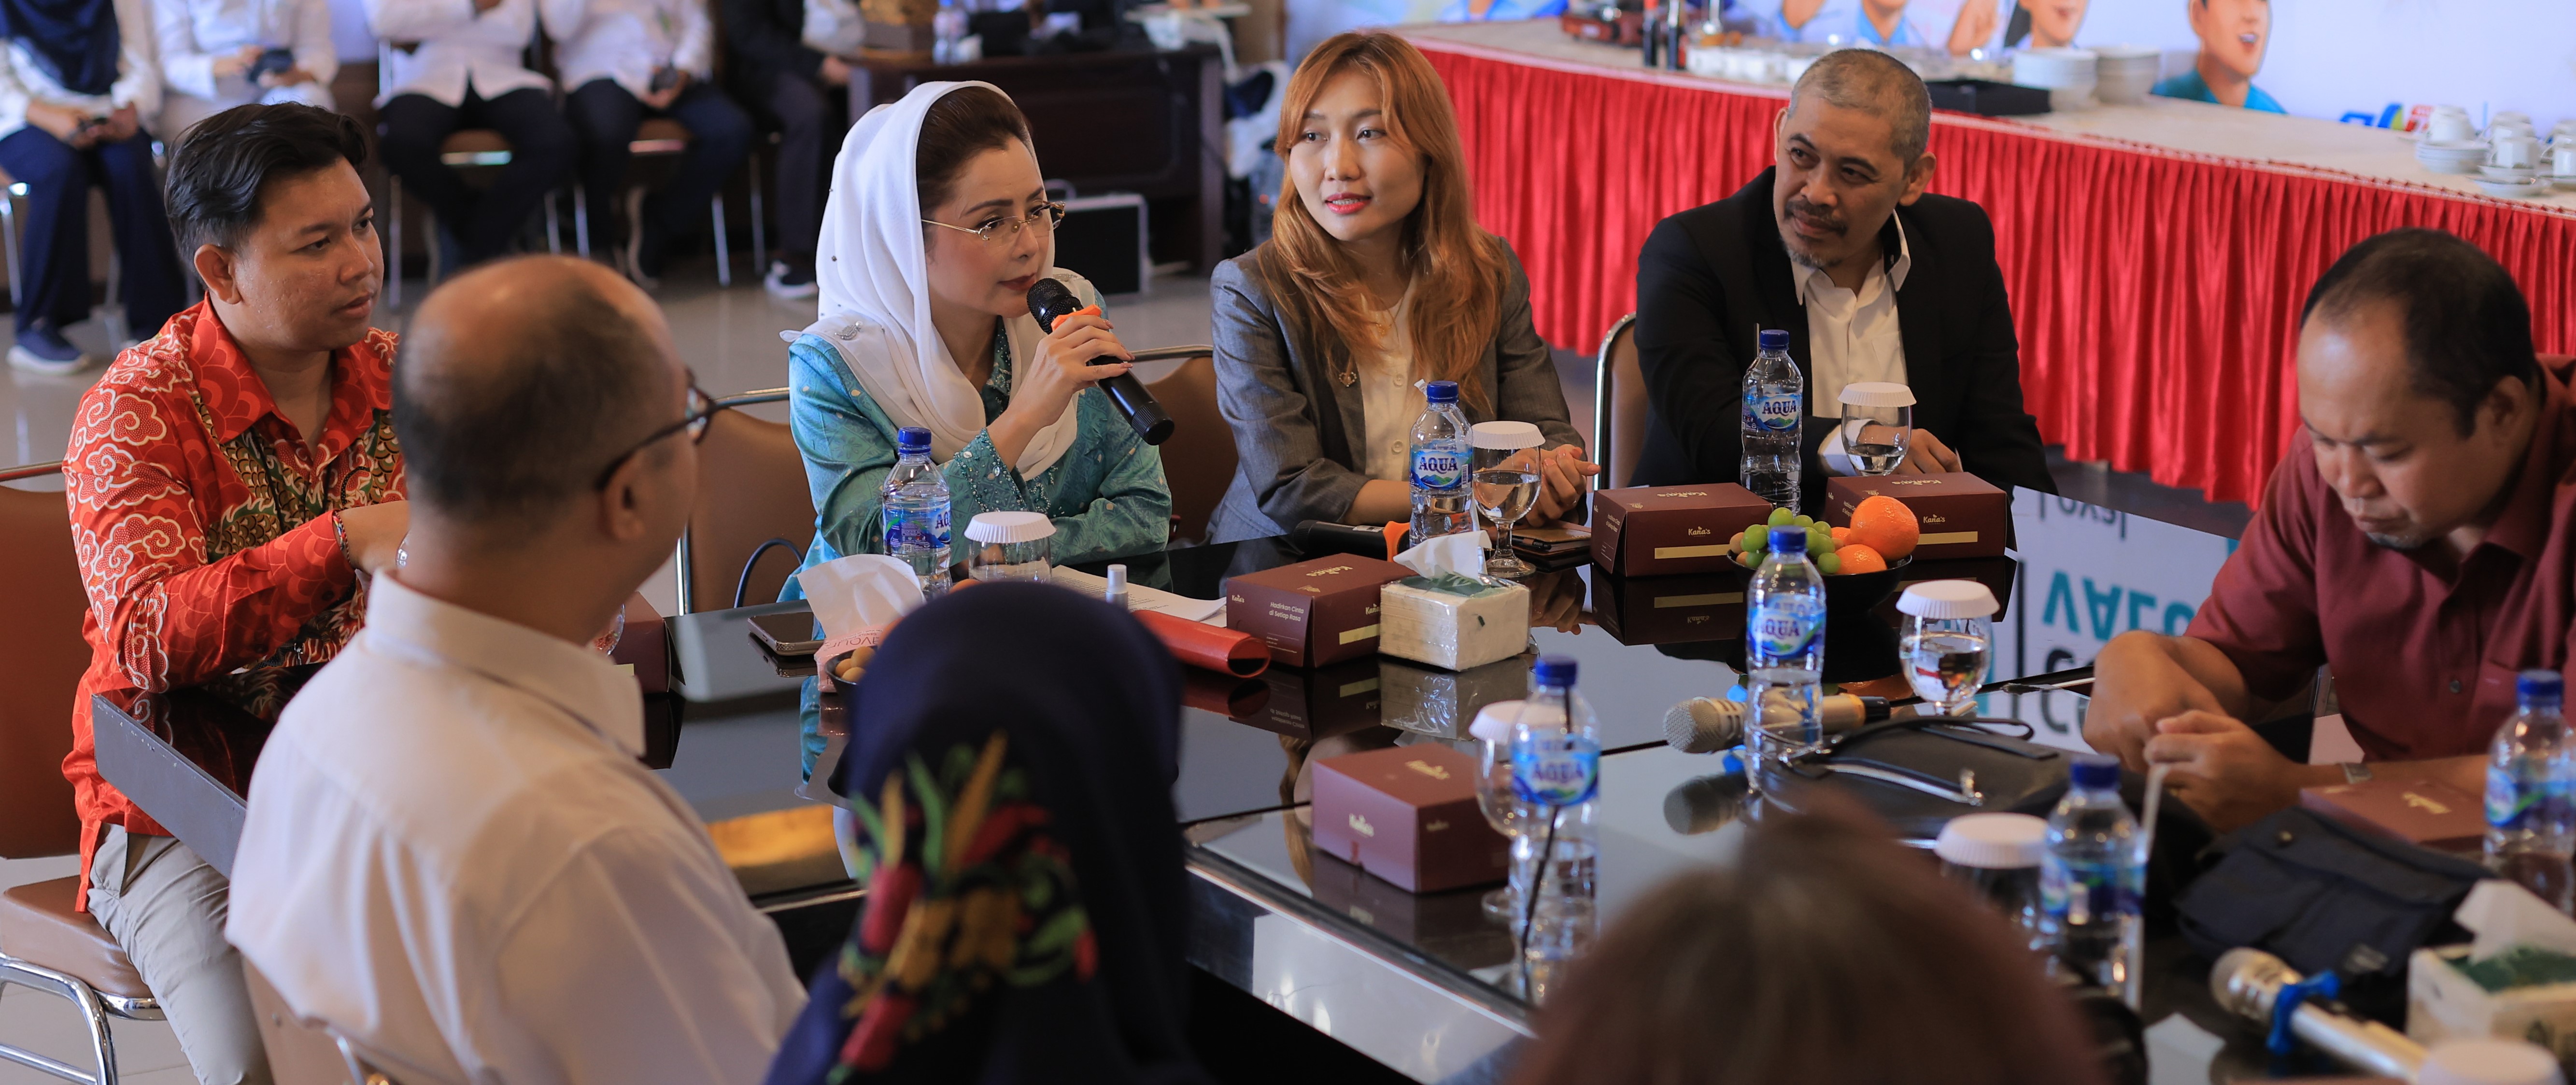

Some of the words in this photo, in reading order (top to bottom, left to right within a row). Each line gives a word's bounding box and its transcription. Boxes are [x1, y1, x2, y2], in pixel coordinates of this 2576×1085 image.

[1762, 400, 1797, 417] AQUA
[1418, 456, 1458, 474] AQUA
[1923, 515, 1946, 523] Kana's
[1688, 526, 1711, 536] Kana's
[1270, 602, 1291, 611] Hadirkan
[1291, 606, 1304, 614] Cinta
[1274, 610, 1289, 620] Setiap
